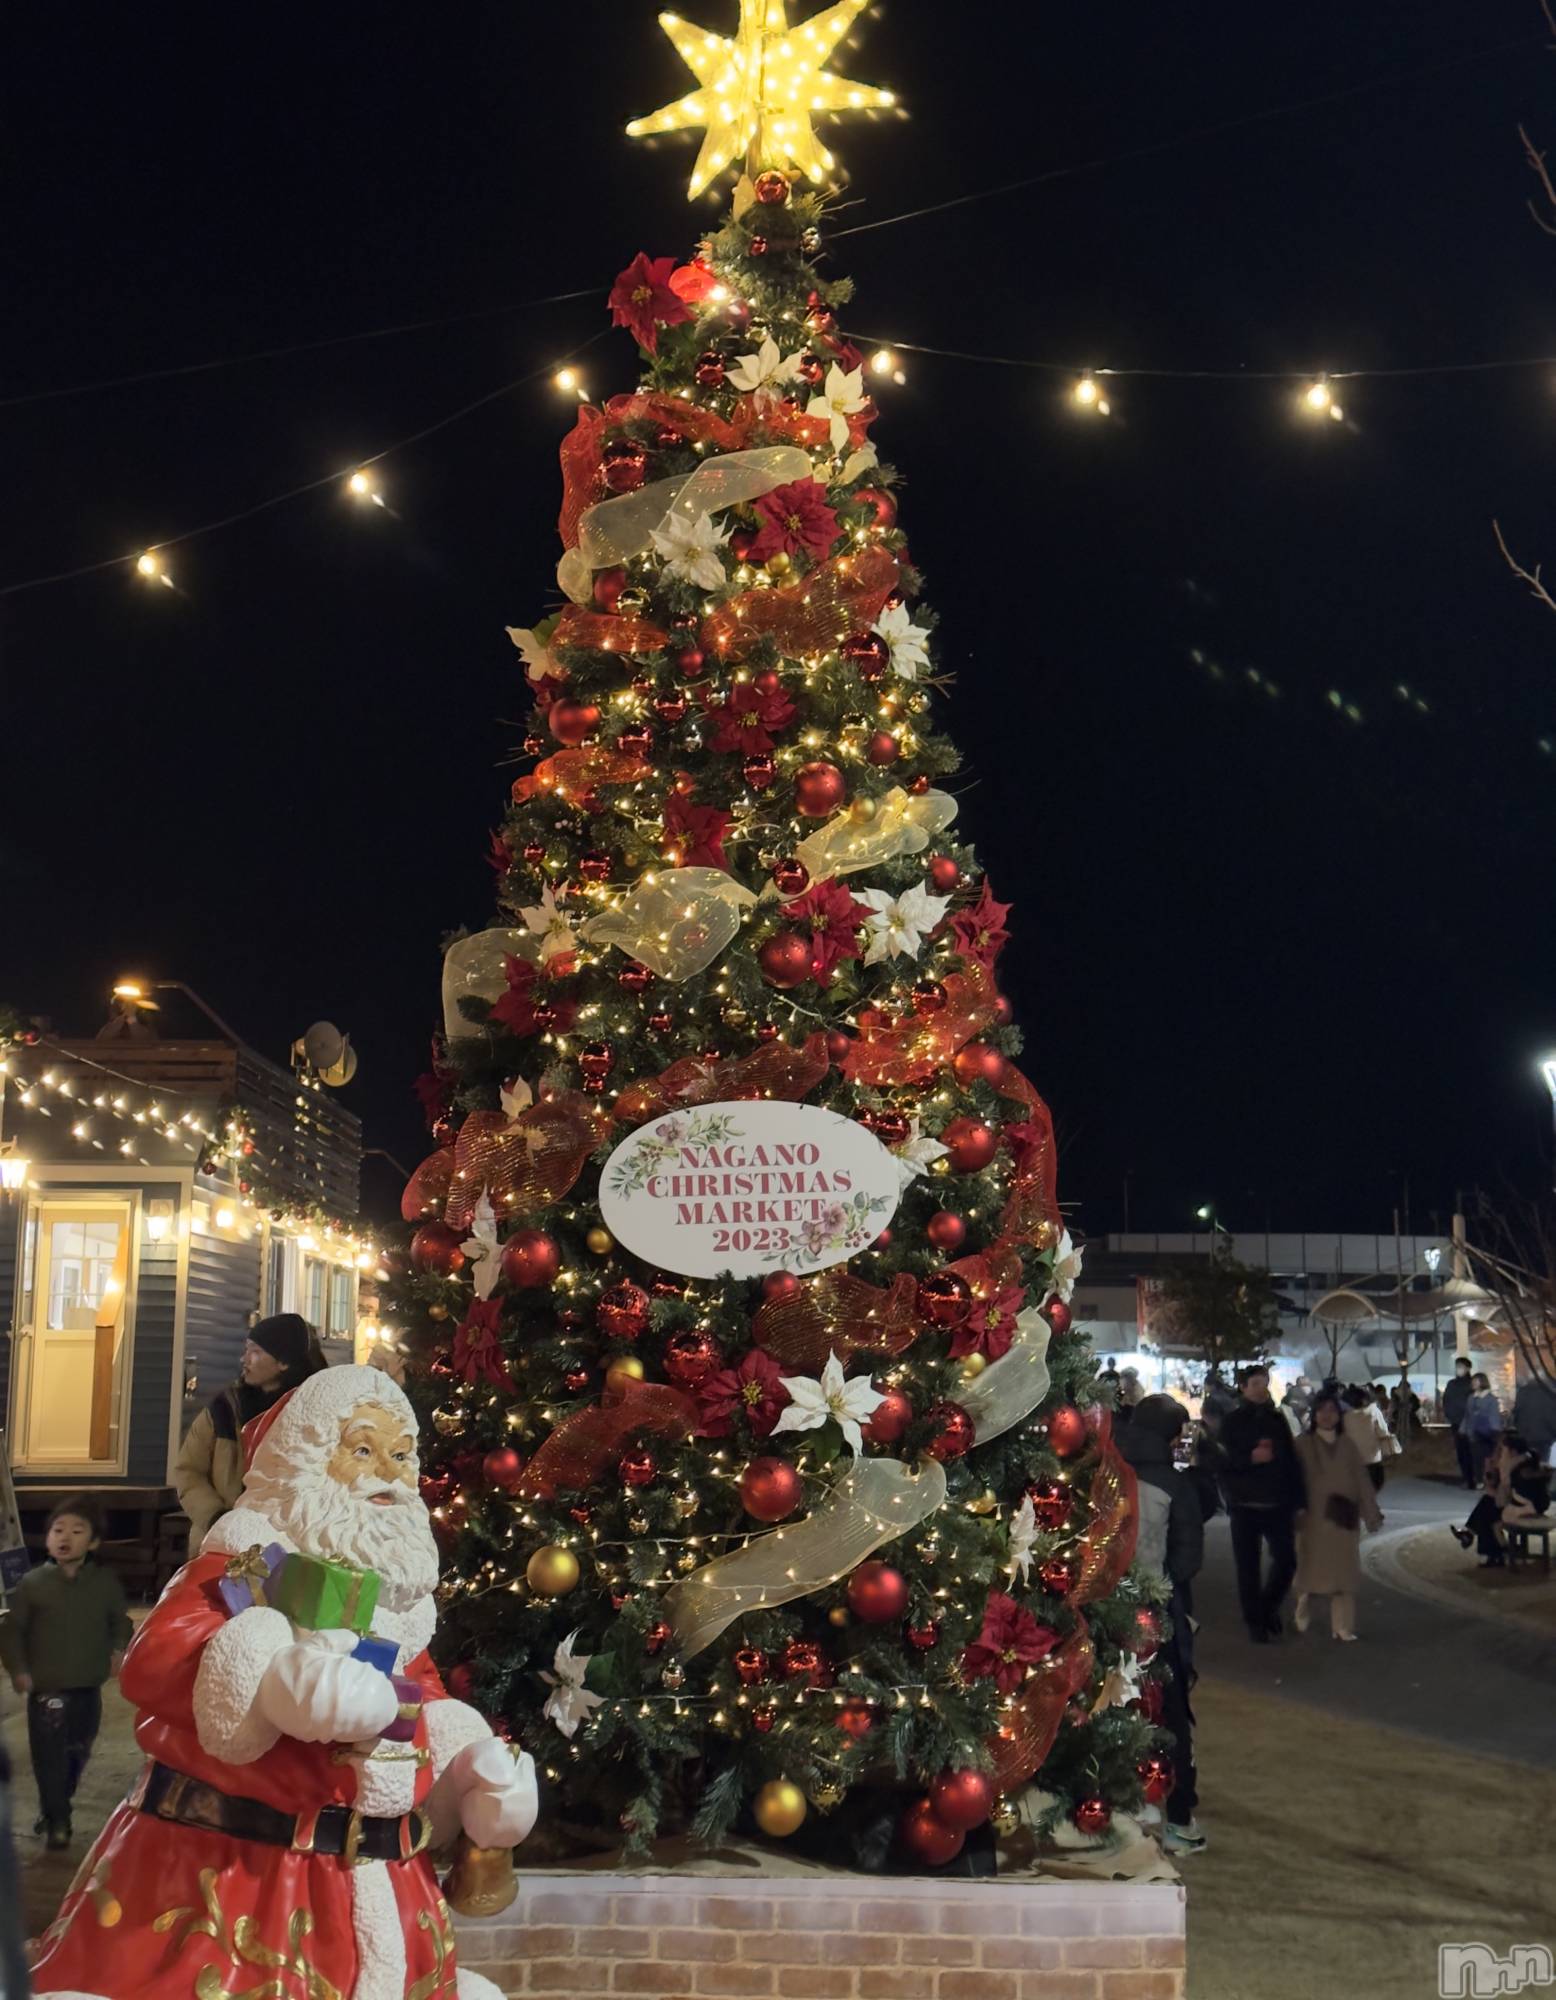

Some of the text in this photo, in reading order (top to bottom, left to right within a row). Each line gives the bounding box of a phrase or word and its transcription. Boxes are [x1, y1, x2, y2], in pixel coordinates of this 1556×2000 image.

[678, 1143, 820, 1169] NAGANO
[646, 1169, 853, 1198] CHRISTMAS
[675, 1199, 826, 1225] MARKET
[712, 1228, 790, 1252] 2023
